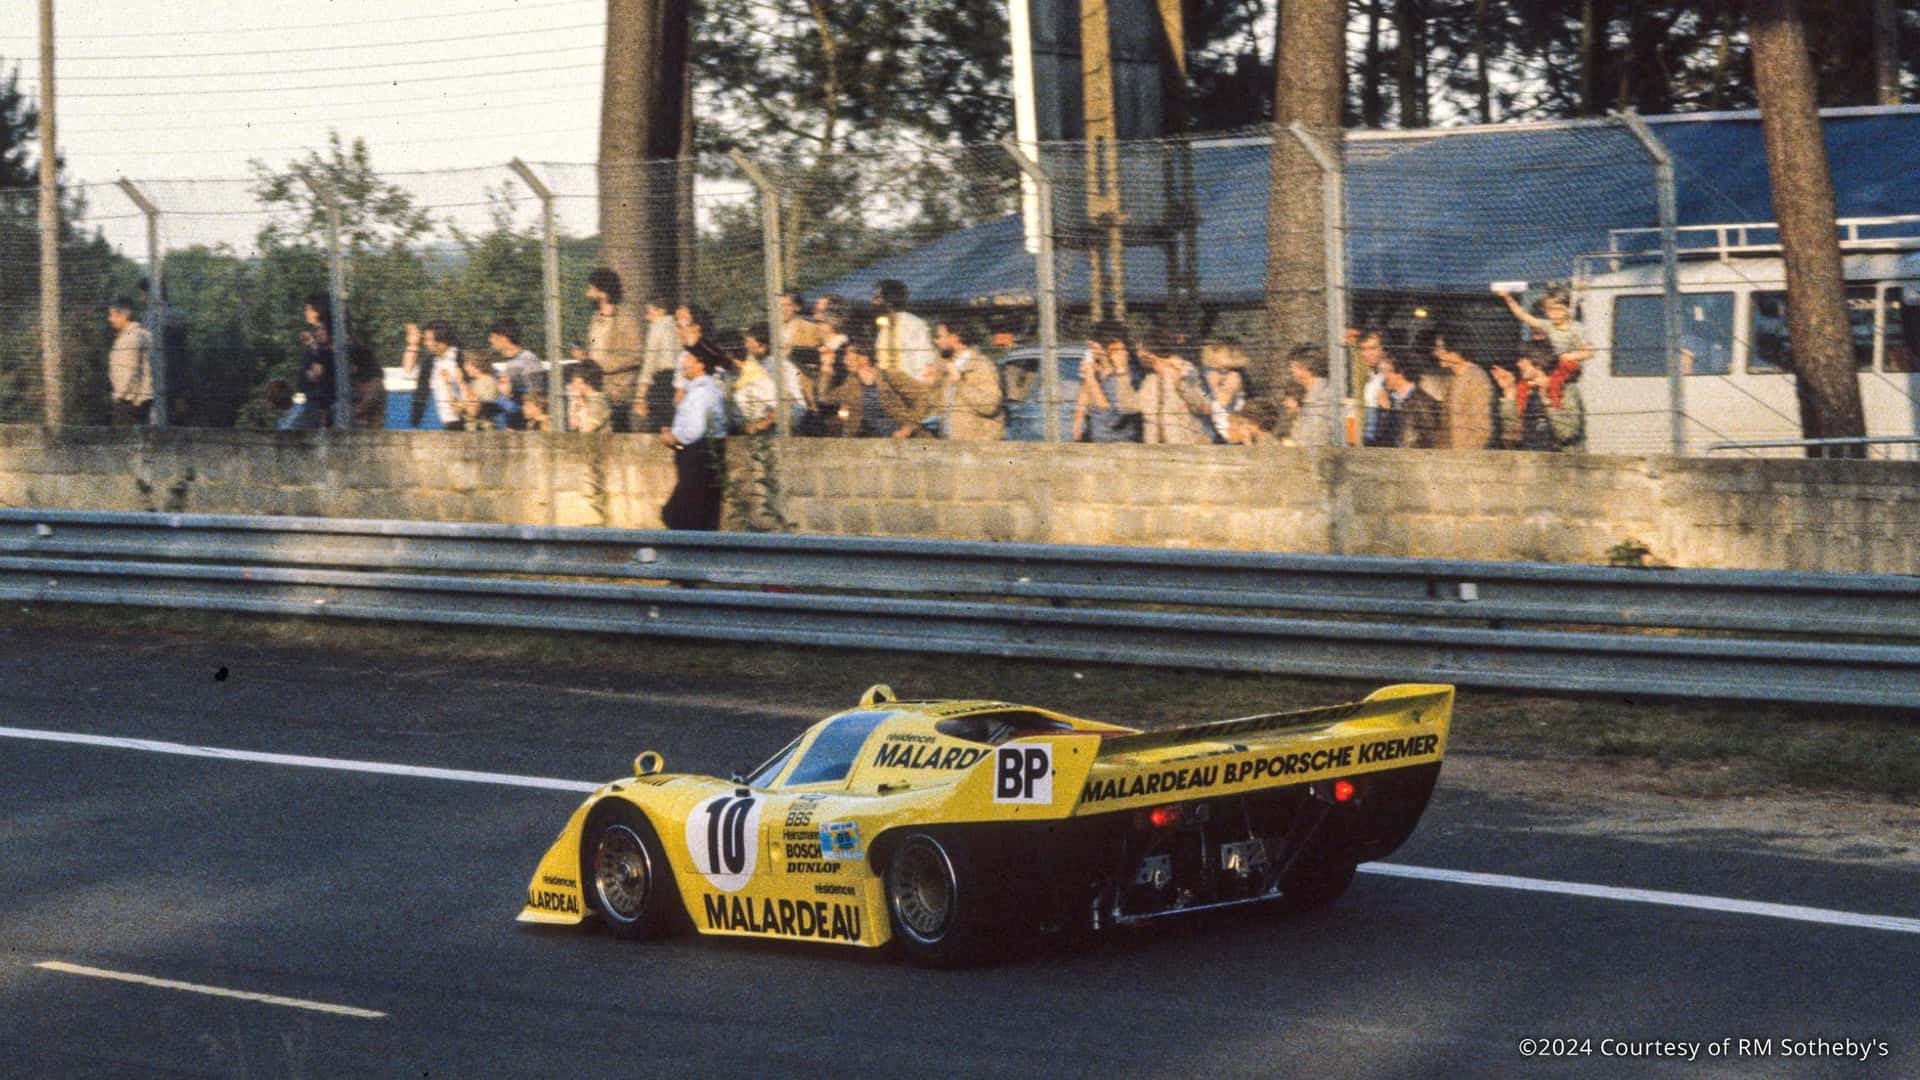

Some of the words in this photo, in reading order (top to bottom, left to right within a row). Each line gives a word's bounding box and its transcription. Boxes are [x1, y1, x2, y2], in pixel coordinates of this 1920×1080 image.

[997, 749, 1049, 798] BP
[1081, 765, 1218, 803] MALARDEAU
[1358, 734, 1438, 764] KREMER
[706, 796, 756, 874] 10
[785, 812, 813, 826] BBS
[786, 844, 822, 858] BOSCH
[787, 862, 840, 873] DUNLOP
[703, 893, 861, 941] MALARDEAU
